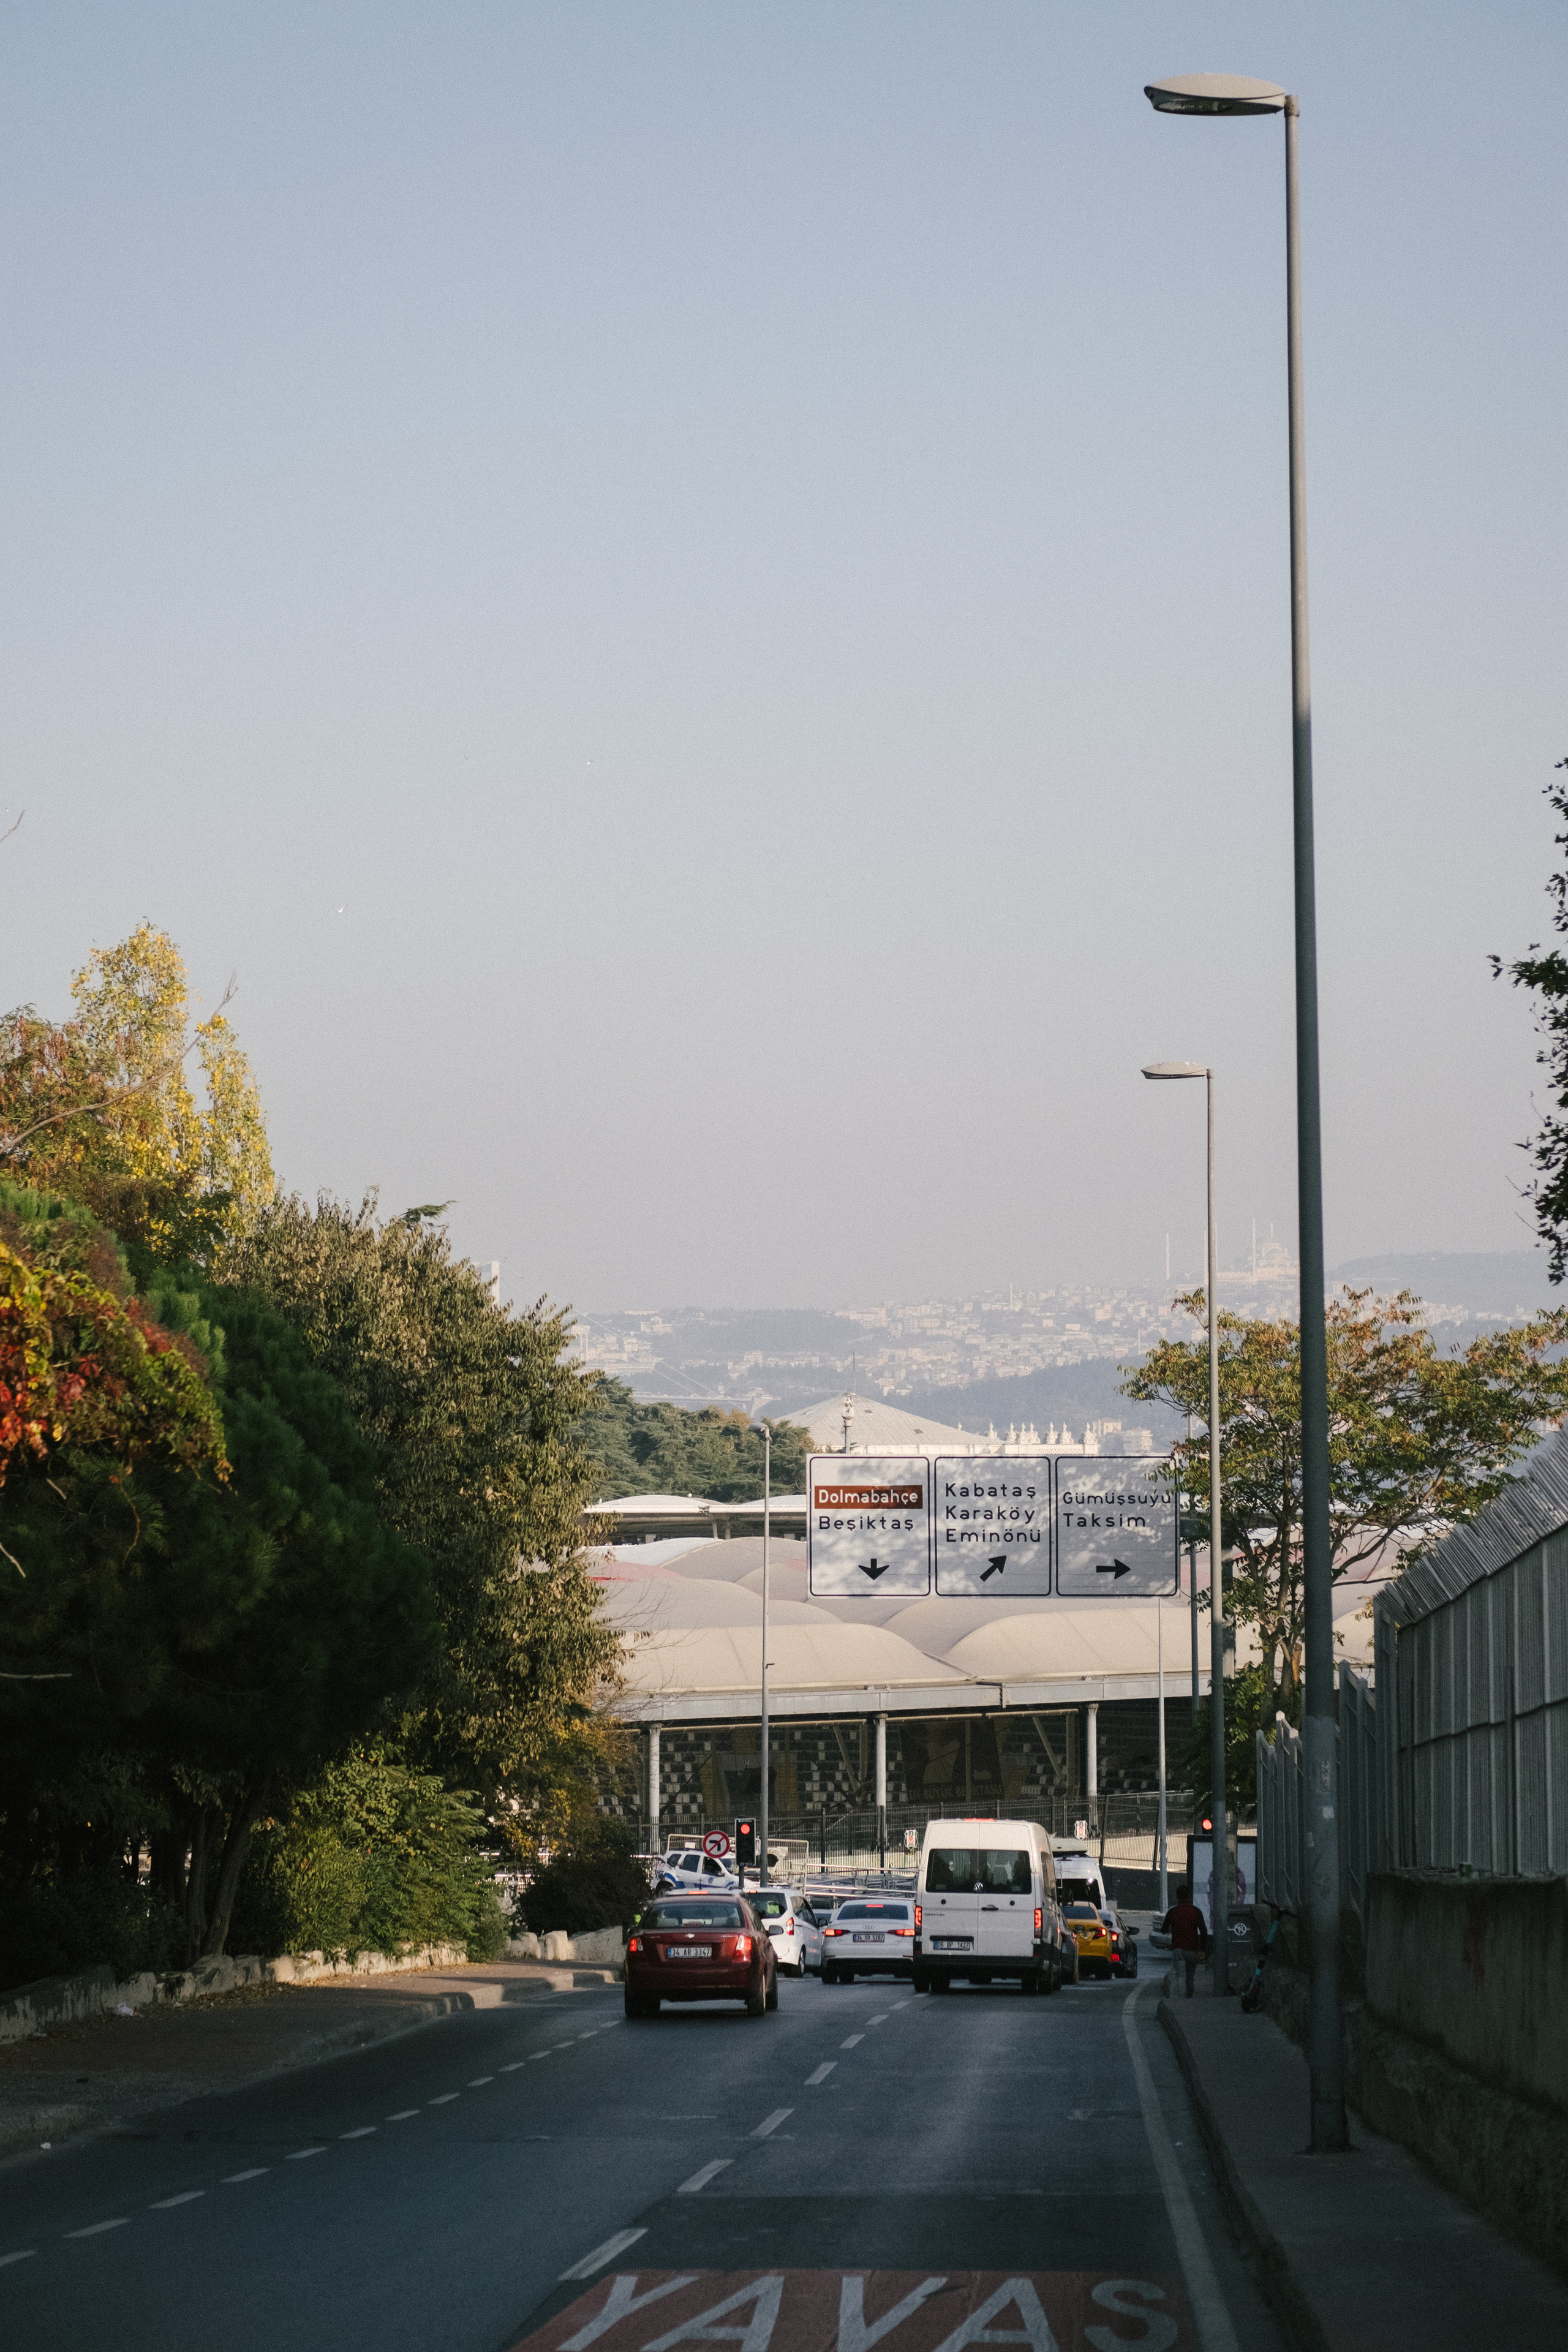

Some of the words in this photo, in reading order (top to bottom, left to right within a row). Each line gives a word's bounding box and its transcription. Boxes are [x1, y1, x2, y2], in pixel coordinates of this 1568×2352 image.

[819, 1490, 918, 1504] Dolmabahçe
[946, 1483, 1036, 1499] Kabataş
[1063, 1491, 1171, 1508] Gümüşsuyu
[946, 1506, 1035, 1523] Karaköy
[1063, 1512, 1146, 1528] Taksim
[819, 1516, 913, 1531] Beşiktaş
[946, 1528, 1041, 1543] Eminönü
